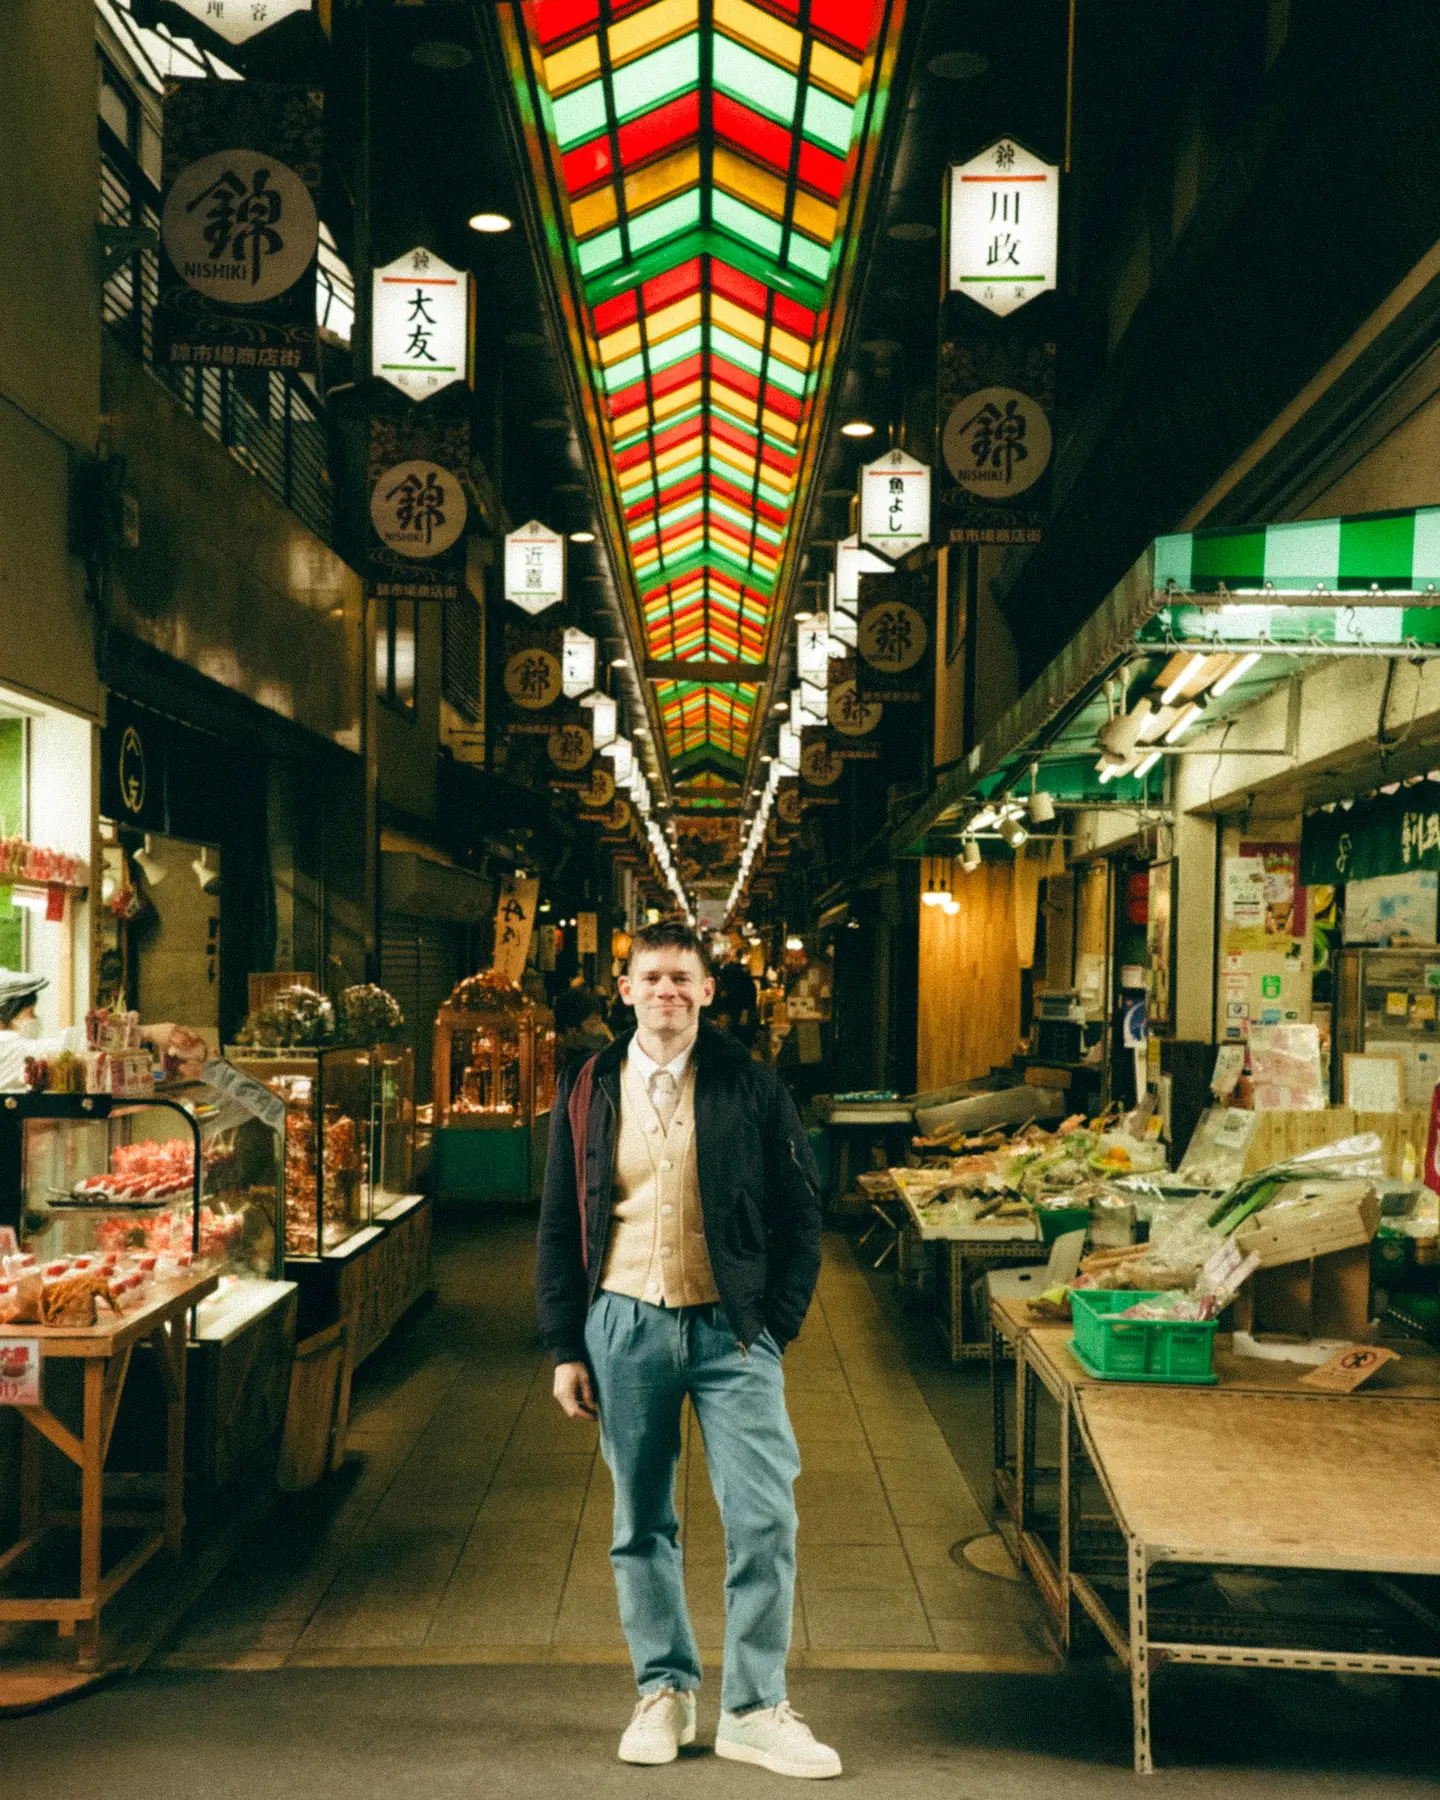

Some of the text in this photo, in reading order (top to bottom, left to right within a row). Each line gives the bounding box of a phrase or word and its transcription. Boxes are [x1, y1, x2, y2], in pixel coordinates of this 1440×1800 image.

[185, 168, 284, 286] 錦
[986, 191, 1021, 267] 川政
[184, 261, 248, 281] NISHIKI
[404, 288, 438, 363] 大友
[957, 469, 1003, 482] NISHIKI
[959, 400, 1028, 485] 錦
[385, 472, 446, 545] 錦
[888, 477, 905, 533] 魚よし
